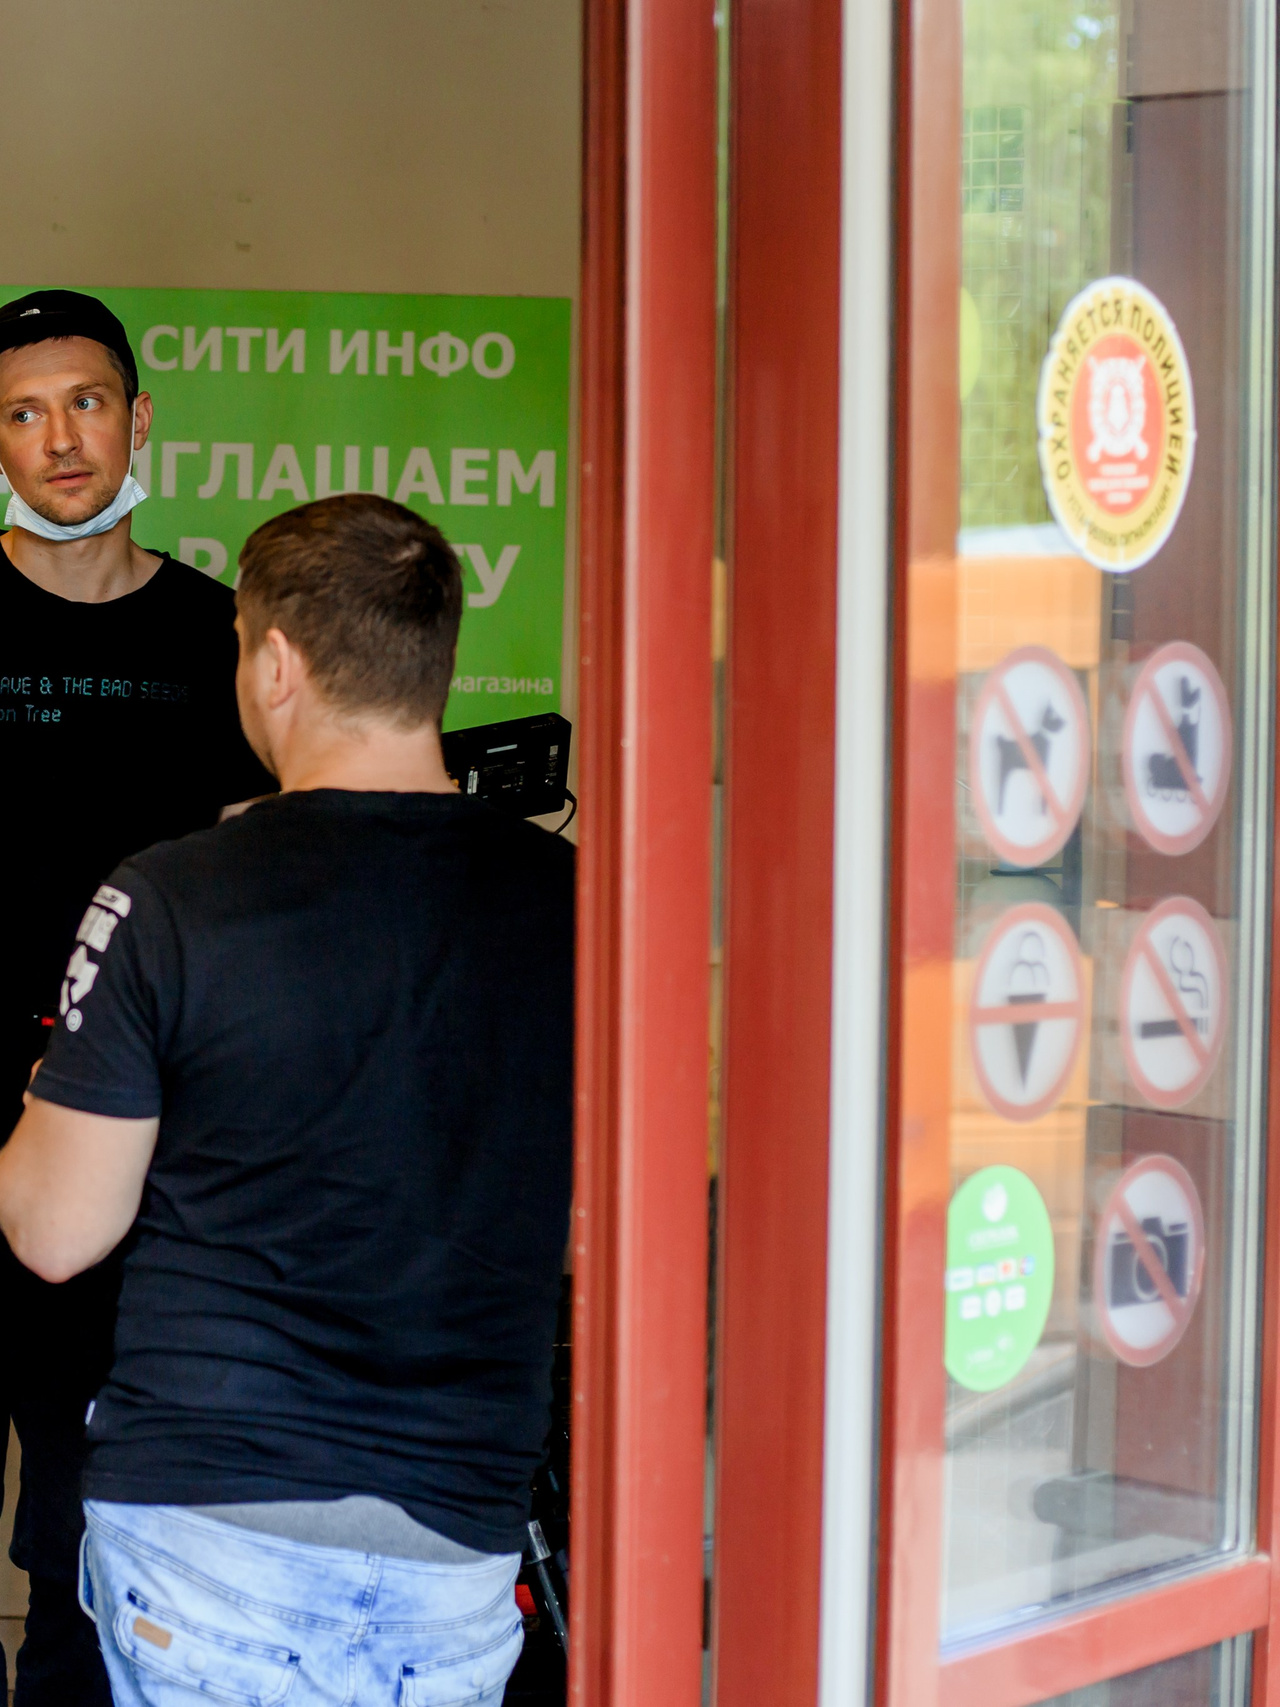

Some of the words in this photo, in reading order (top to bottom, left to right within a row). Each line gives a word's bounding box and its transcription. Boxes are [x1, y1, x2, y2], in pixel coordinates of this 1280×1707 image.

[140, 325, 306, 374] СИТИ
[328, 329, 516, 379] ИНФО
[1051, 298, 1122, 481] ОХРАНЯЕТСЯ
[39, 676, 54, 695] &
[62, 677, 94, 696] THE
[100, 678, 133, 698] BAD
[25, 704, 62, 722] Tree
